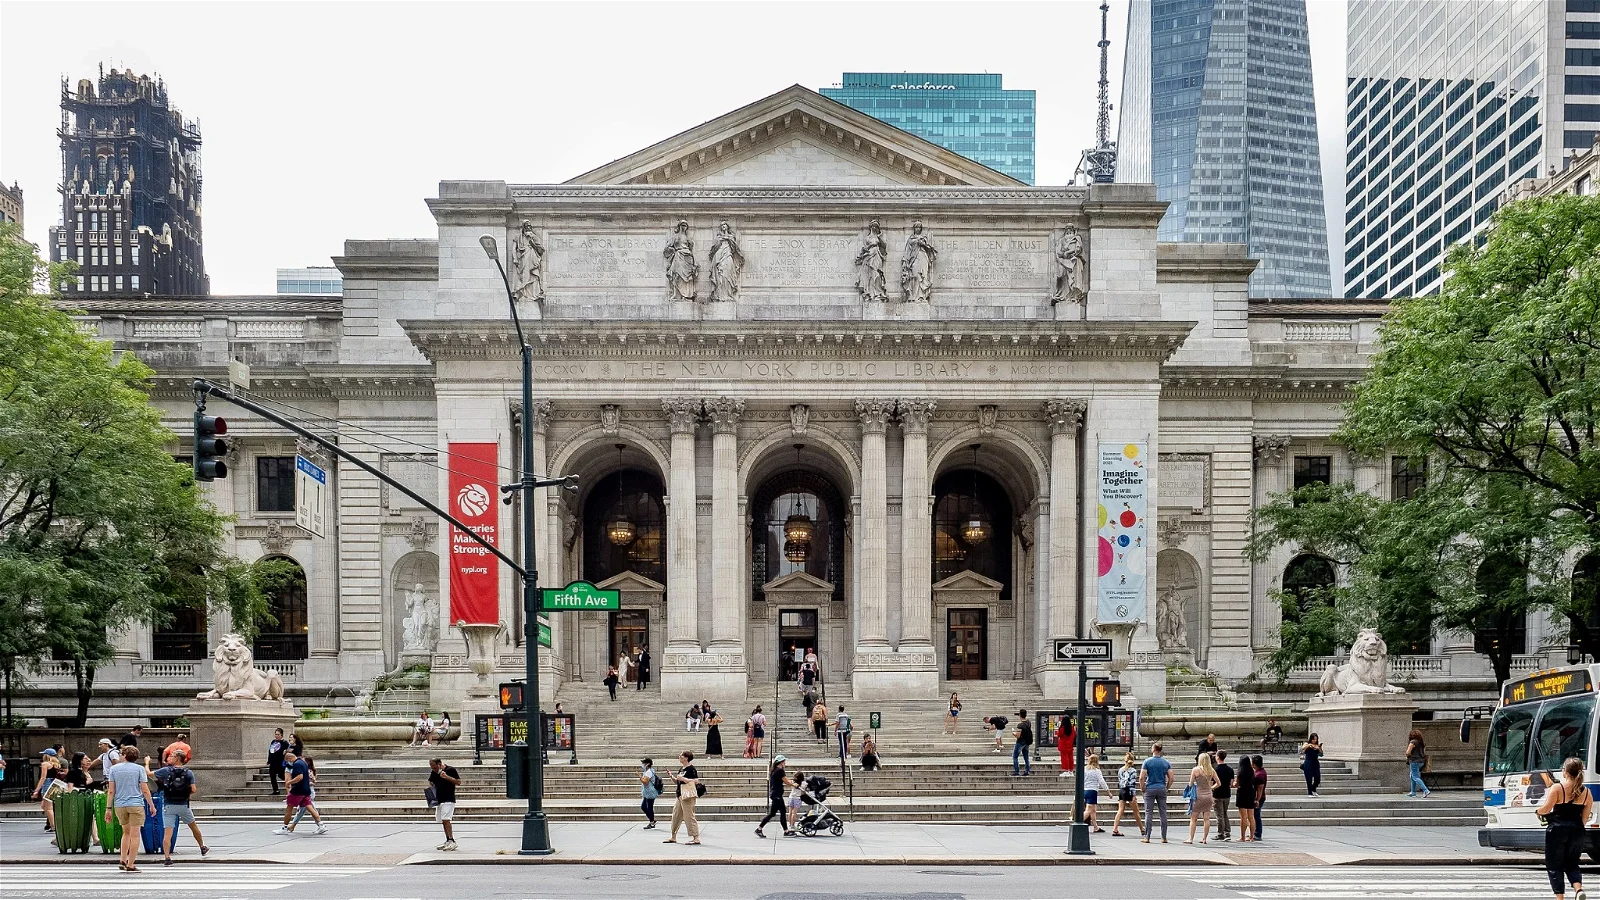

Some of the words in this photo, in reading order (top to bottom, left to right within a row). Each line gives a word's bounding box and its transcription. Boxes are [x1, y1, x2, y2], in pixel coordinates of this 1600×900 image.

[555, 239, 574, 249] THE
[580, 239, 613, 249] ASTOR
[617, 239, 660, 249] LIBRARY
[747, 239, 767, 249] THE
[772, 239, 805, 249] LENOX
[811, 239, 853, 249] LIBRARY
[938, 240, 958, 250] THE
[967, 240, 1002, 250] TILDEN
[1011, 240, 1042, 250] TRUST
[770, 258, 797, 266] JAMES
[802, 258, 829, 266] LENOX
[516, 365, 587, 374] MCCCXCV
[626, 362, 667, 376] THE
[681, 362, 729, 376] NEW
[744, 362, 795, 376] YORK
[810, 363, 877, 376] PUBLIC
[894, 363, 973, 377] LIBRARY
[1102, 469, 1139, 479] Imagine
[1102, 477, 1144, 487] Together
[453, 523, 495, 533] Laries
[453, 544, 493, 557] Stronge
[461, 565, 488, 575] nypl.org
[554, 593, 581, 606] Fifth
[584, 594, 608, 606] Ave
[1064, 646, 1080, 654] ONE
[1544, 674, 1573, 688] BROADWAY
[1513, 683, 1526, 701] M4
